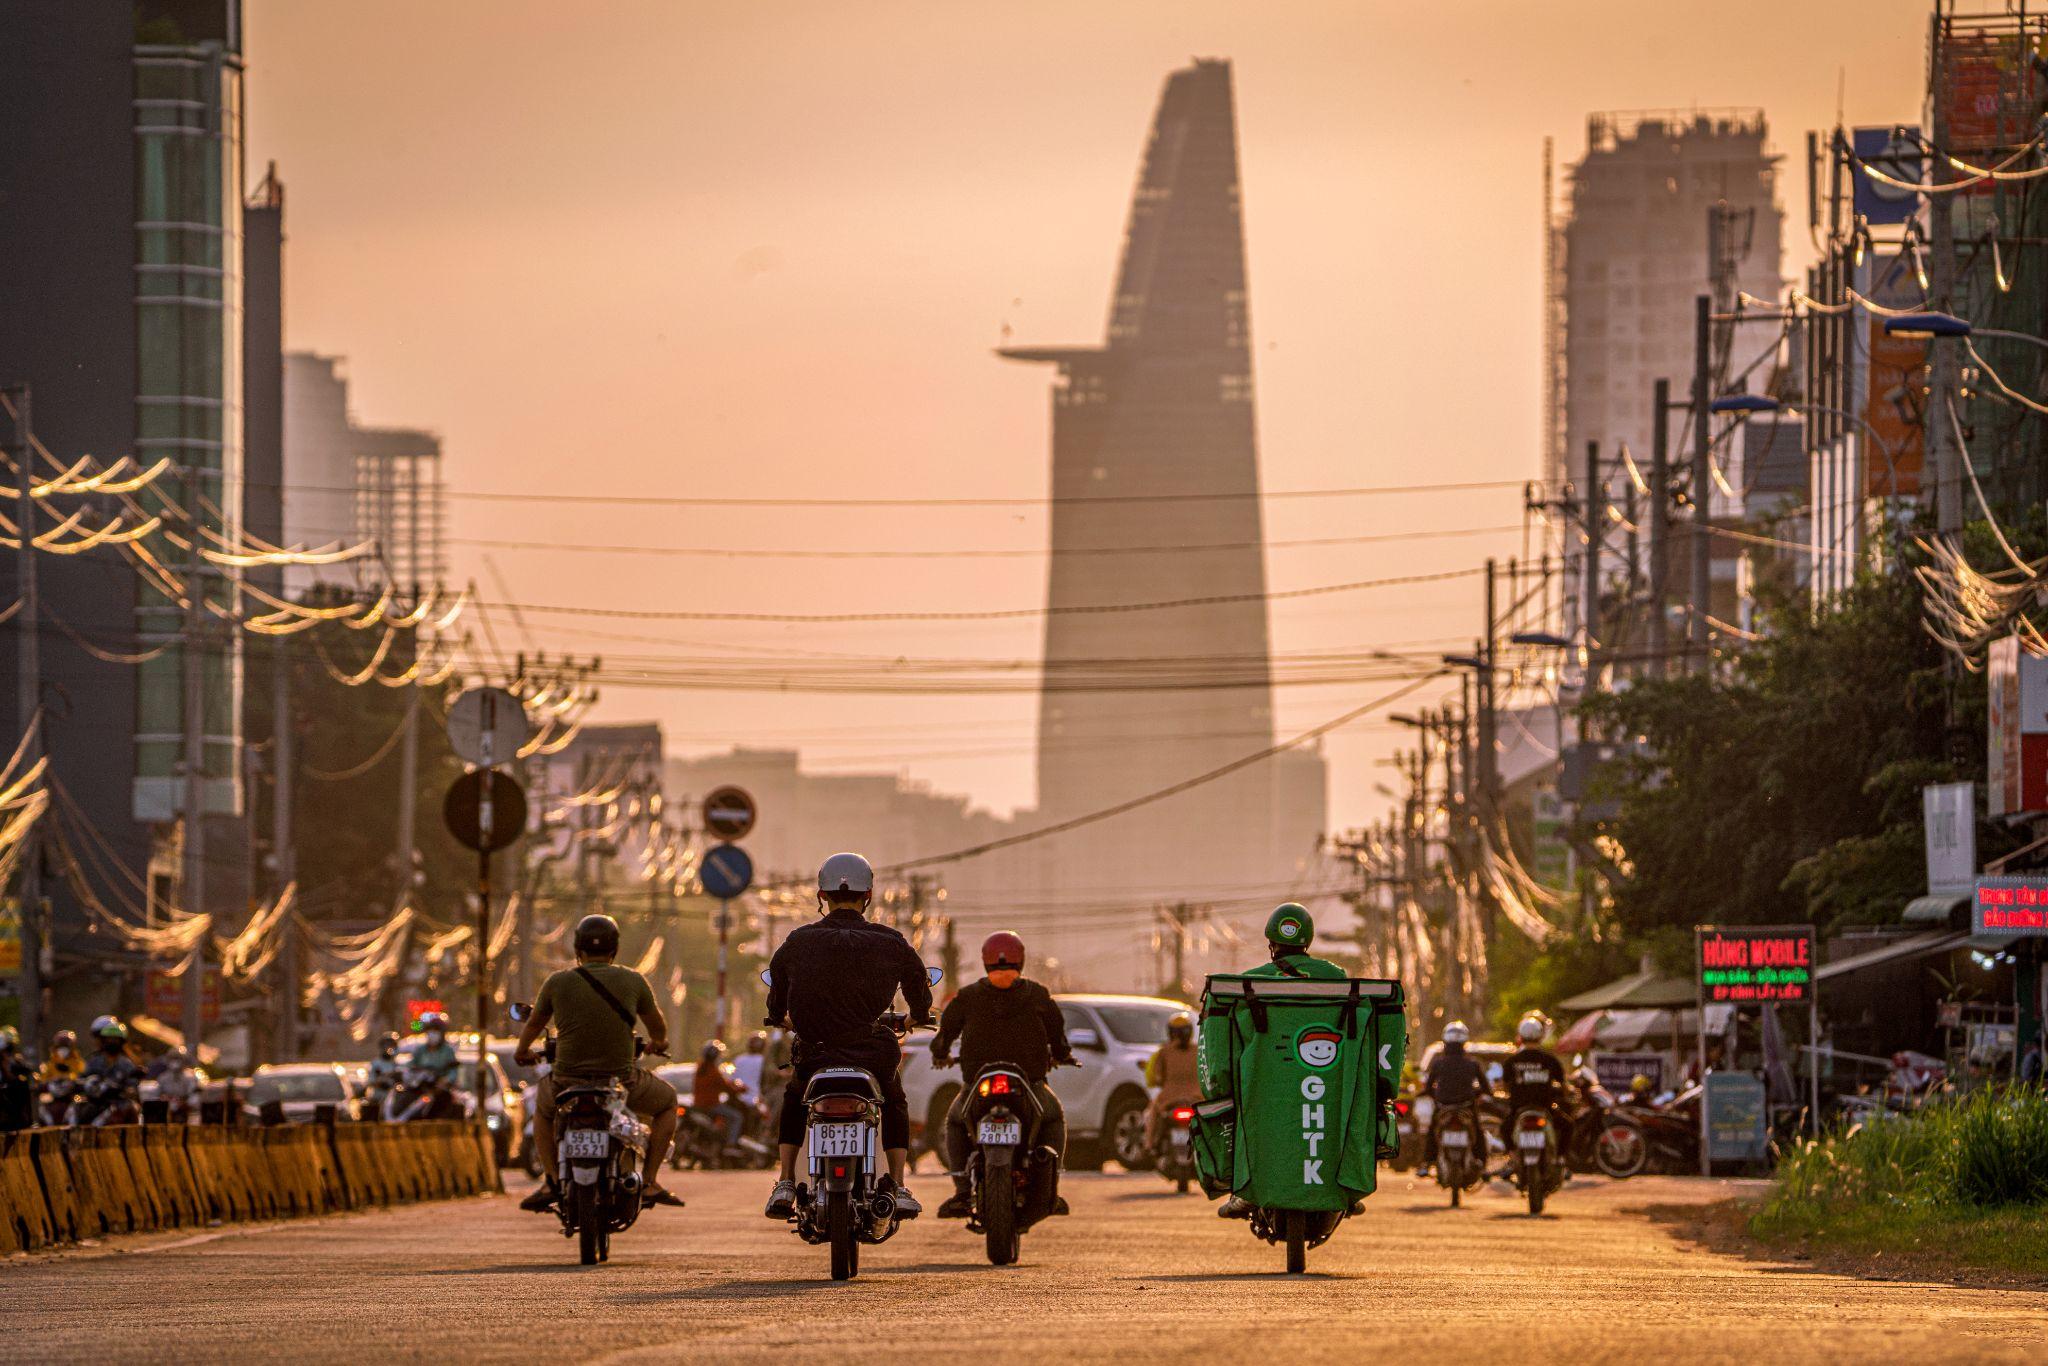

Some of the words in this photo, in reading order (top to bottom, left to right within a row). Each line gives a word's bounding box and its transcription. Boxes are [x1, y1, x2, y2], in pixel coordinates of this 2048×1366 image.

[1750, 938, 1809, 967] MOBILE
[821, 1124, 858, 1139] 86-F3
[1301, 1075, 1325, 1185] GHTK
[821, 1140, 858, 1154] 4170
